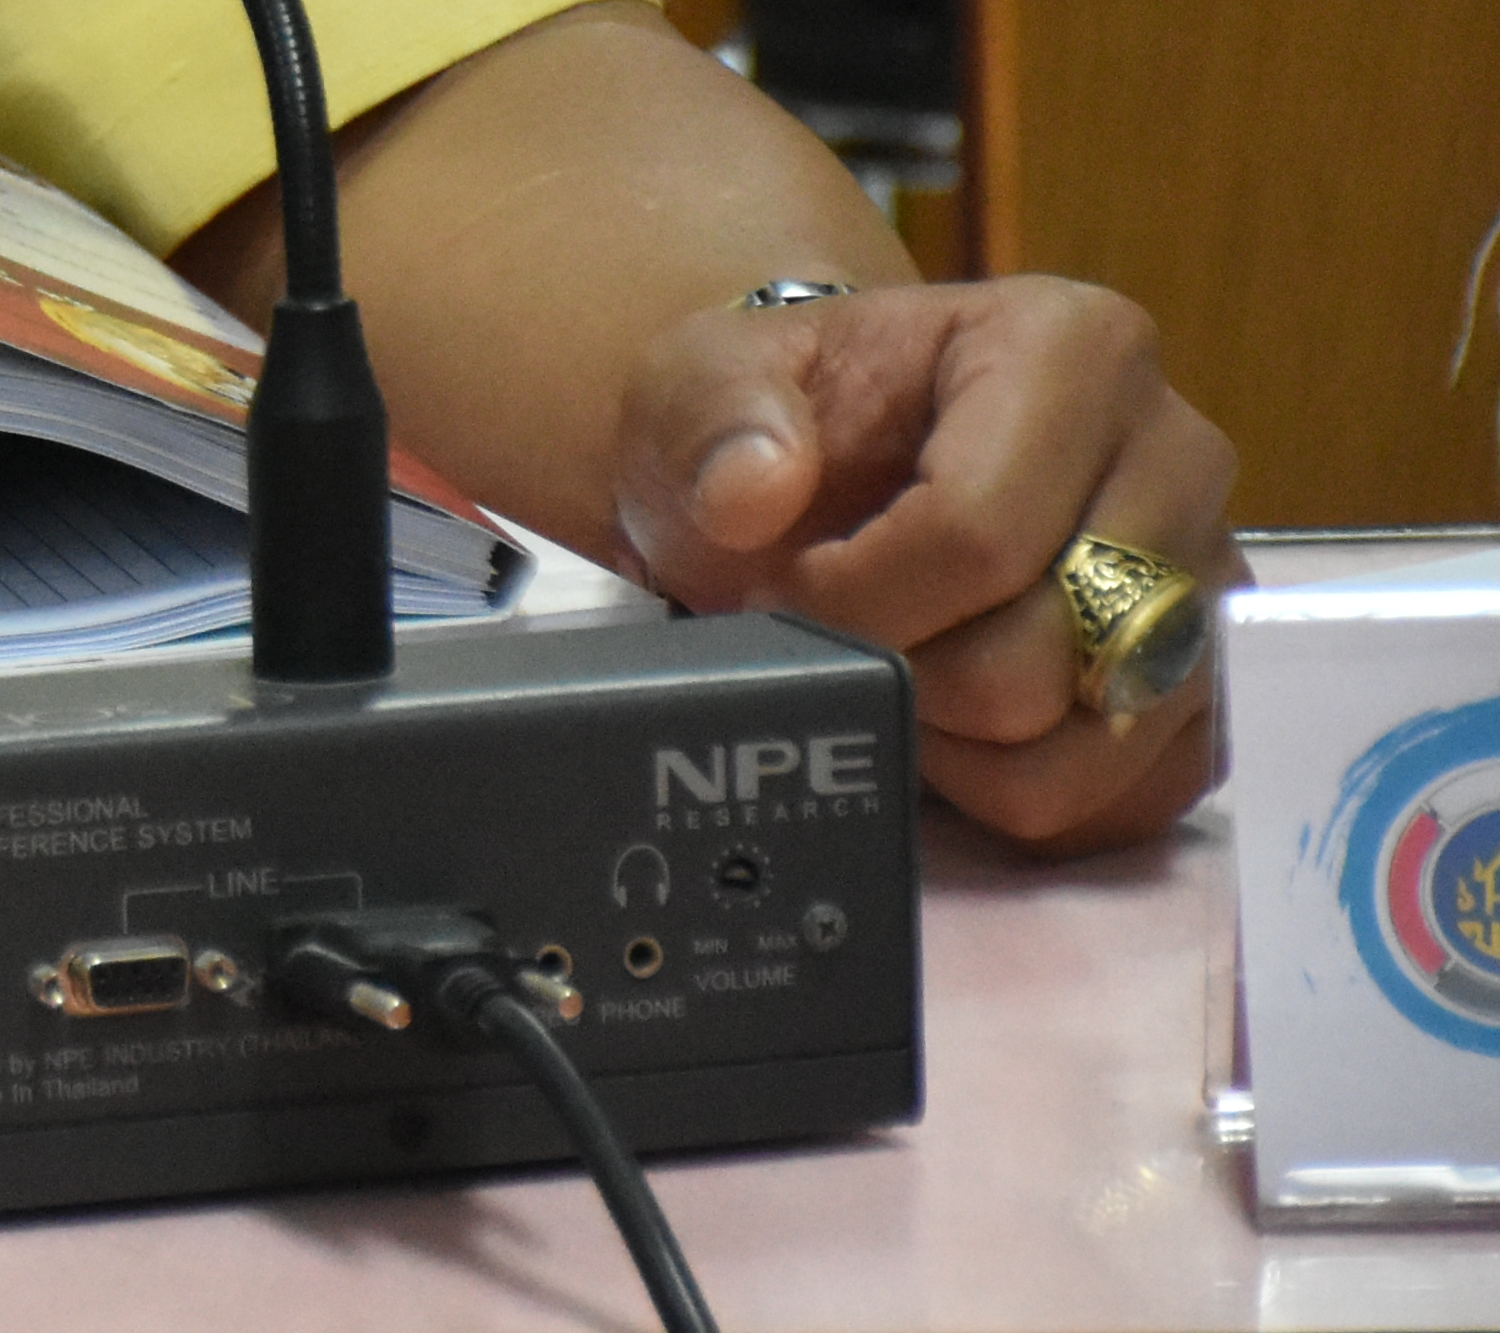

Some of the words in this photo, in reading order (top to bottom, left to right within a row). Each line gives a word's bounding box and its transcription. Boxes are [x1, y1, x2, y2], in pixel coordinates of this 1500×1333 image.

[655, 733, 879, 808] NPE
[655, 796, 880, 831] RESEARCH
[137, 817, 253, 851] SYSTEM
[208, 869, 280, 901] LINE
[694, 963, 798, 992] VOLUME
[599, 996, 687, 1023] PHONE
[8, 1052, 37, 1079] by
[43, 1047, 93, 1071] NPE
[42, 1074, 139, 1101] Thailand
